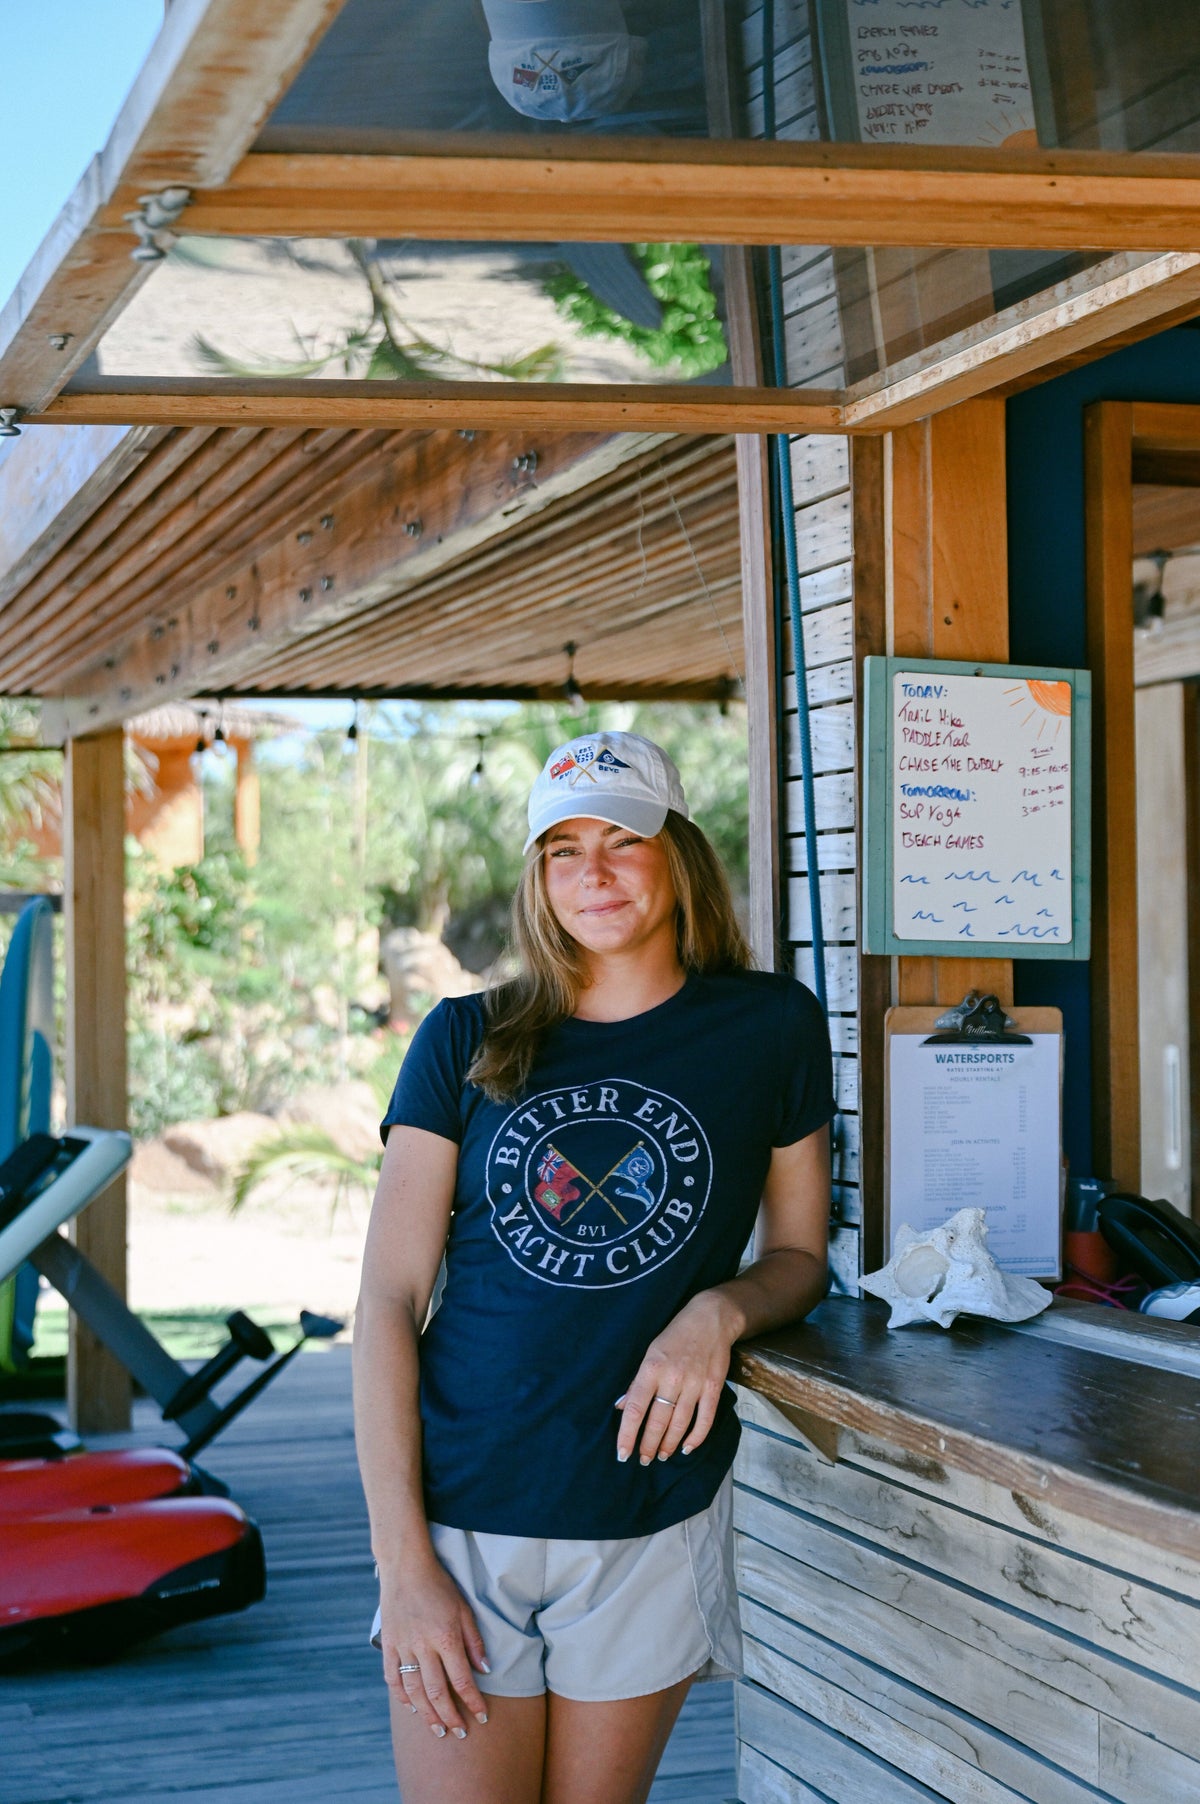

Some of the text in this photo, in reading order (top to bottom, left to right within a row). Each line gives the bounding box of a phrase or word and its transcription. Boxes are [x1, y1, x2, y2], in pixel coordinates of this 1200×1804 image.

[901, 683, 948, 698] TODAY:
[902, 727, 941, 747] PADDLE
[899, 755, 939, 772] CHASE
[941, 754, 962, 772] THE
[900, 783, 977, 802] TOMORROW:
[902, 831, 984, 850] BEACH GAMES
[935, 1053, 1015, 1064] WATERSPORTS
[495, 1087, 700, 1168] BITTER END
[499, 1198, 693, 1277] YACHT CLUB
[577, 1224, 607, 1237] BVI
